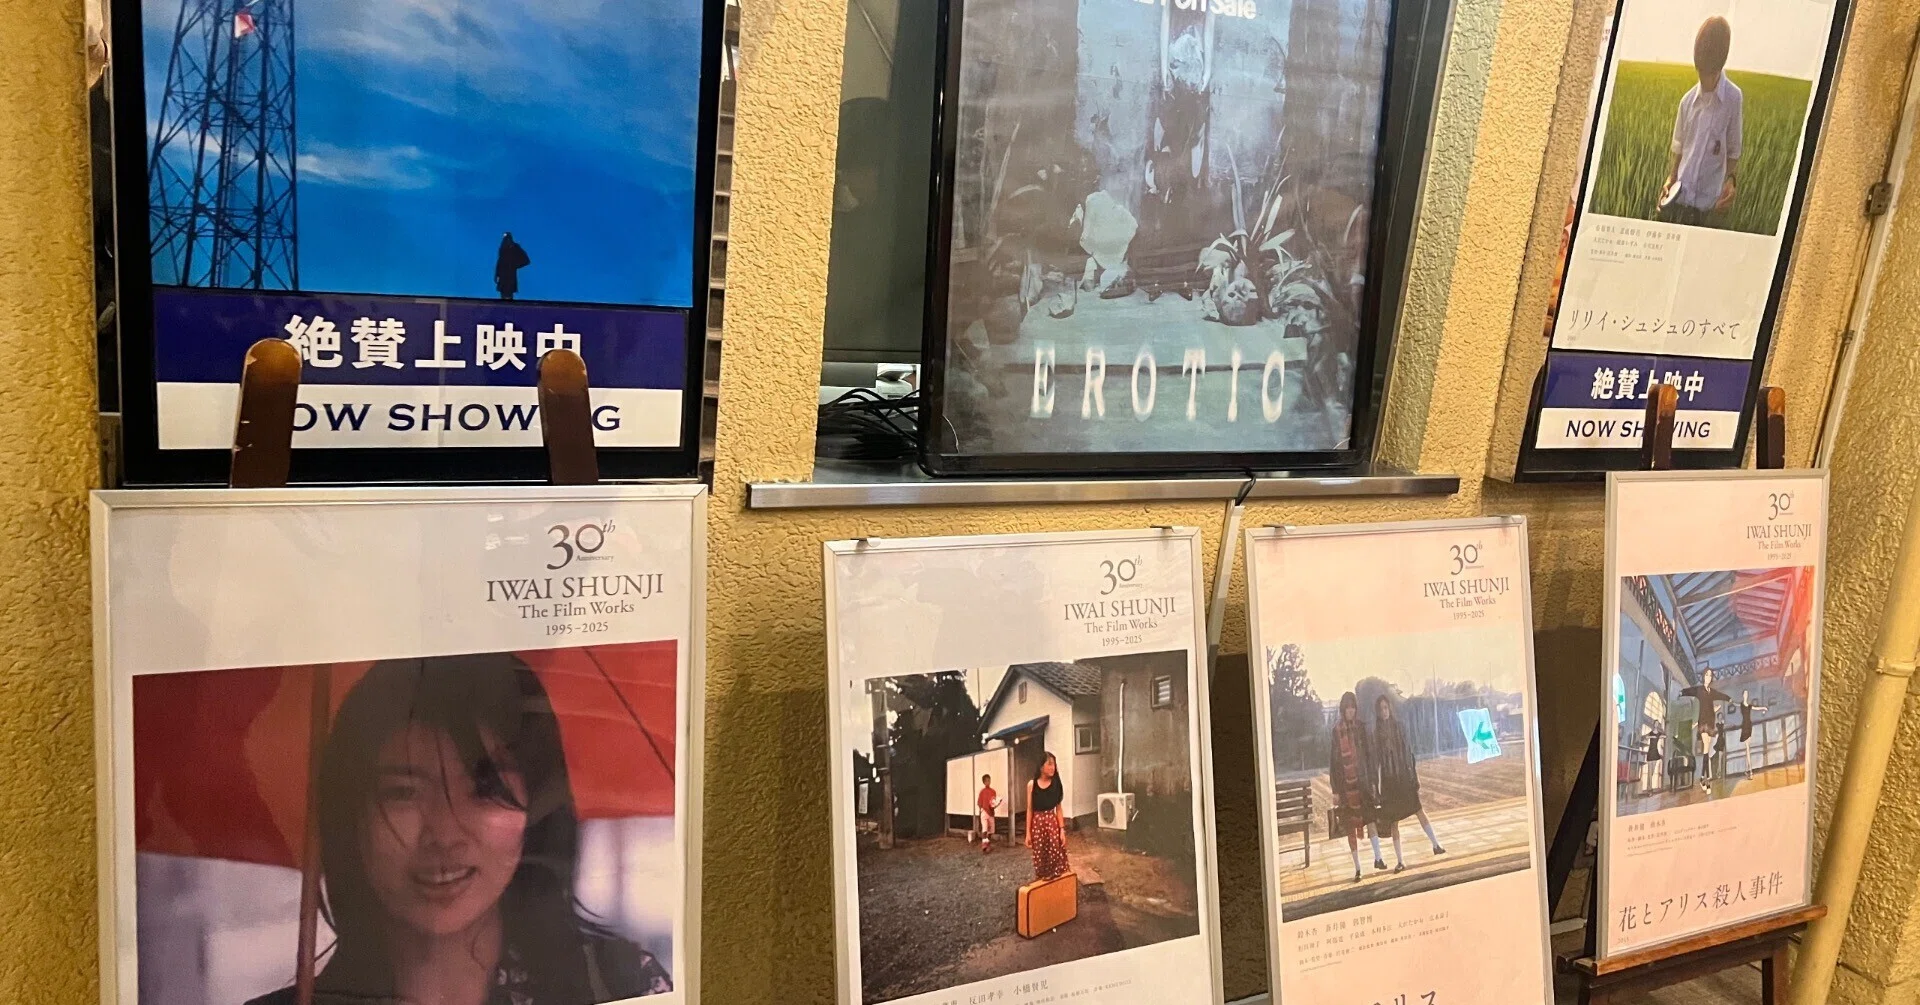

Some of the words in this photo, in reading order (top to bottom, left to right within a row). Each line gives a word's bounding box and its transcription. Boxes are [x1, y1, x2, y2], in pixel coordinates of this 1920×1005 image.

[1209, 0, 1257, 20] Sale
[1569, 309, 1741, 340] リリイ・シュシュのすべて
[284, 314, 582, 371] 絶賛上映中
[292, 403, 371, 431] OW
[387, 403, 622, 431] SHOWG
[1566, 420, 1616, 438] NOW
[1620, 420, 1711, 438] SHING
[1746, 525, 1771, 539] IWAI
[1773, 524, 1812, 540] SHUNJI
[1757, 541, 1769, 550] The
[1770, 540, 1784, 549] Film
[1784, 540, 1801, 549] Works
[575, 555, 614, 563] Anniversary
[487, 578, 552, 602] IWAI
[562, 573, 664, 600] SHUNJI
[1424, 581, 1455, 597] IWAI
[1460, 577, 1510, 595] SHUNJI
[518, 604, 548, 619] The
[553, 603, 586, 617] Film
[589, 600, 635, 615] Works
[1064, 601, 1106, 620] IWAI
[1111, 597, 1176, 617] SHUNJI
[1440, 598, 1454, 609] The
[1456, 598, 1473, 608] Film
[1473, 595, 1497, 606] Works
[1084, 622, 1103, 634] The
[1106, 620, 1128, 632] Film
[1129, 618, 1158, 629] Works
[1618, 871, 1783, 932] 花とアリス殺人事件
